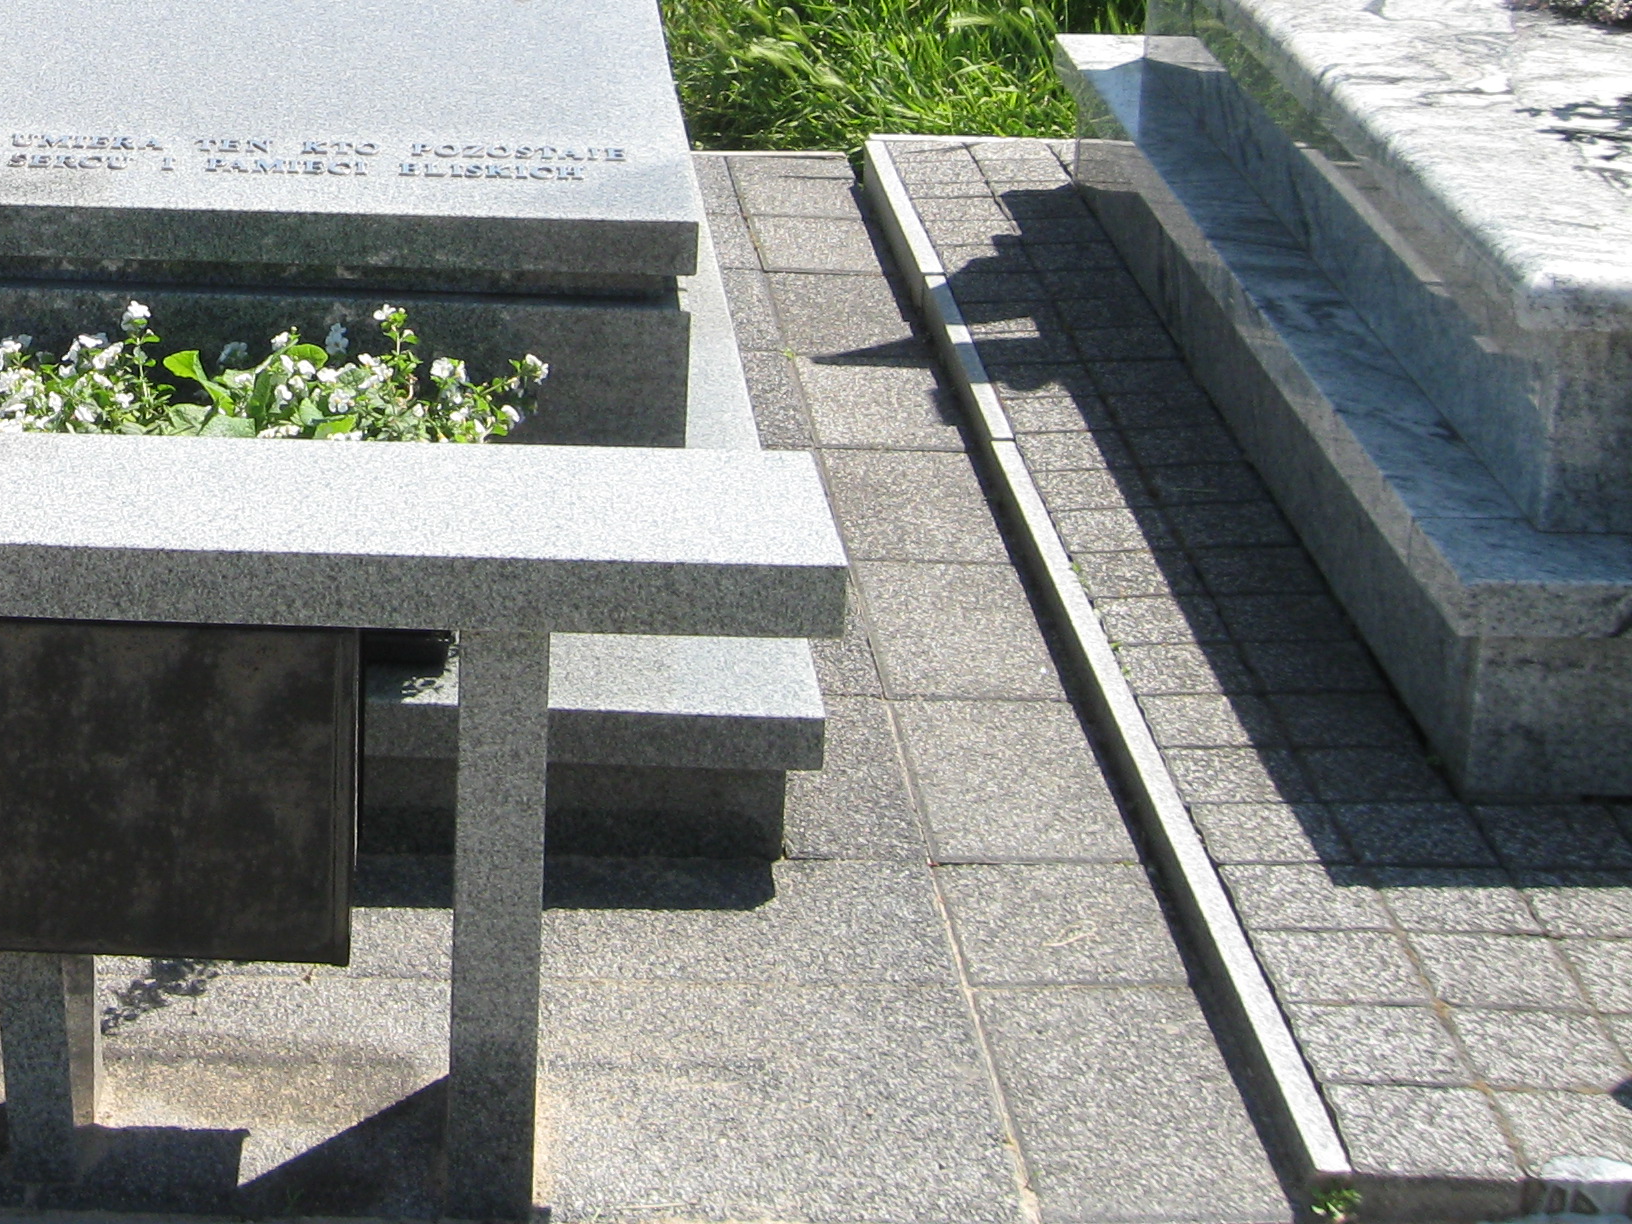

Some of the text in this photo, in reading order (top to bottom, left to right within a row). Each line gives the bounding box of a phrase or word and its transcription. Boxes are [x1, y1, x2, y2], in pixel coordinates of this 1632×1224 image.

[11, 132, 164, 151] UMIERA
[195, 138, 273, 153] TEN
[301, 141, 381, 156] KTO
[7, 153, 134, 170] SERCU
[161, 156, 176, 171] I
[398, 162, 585, 181] BLISKICH
